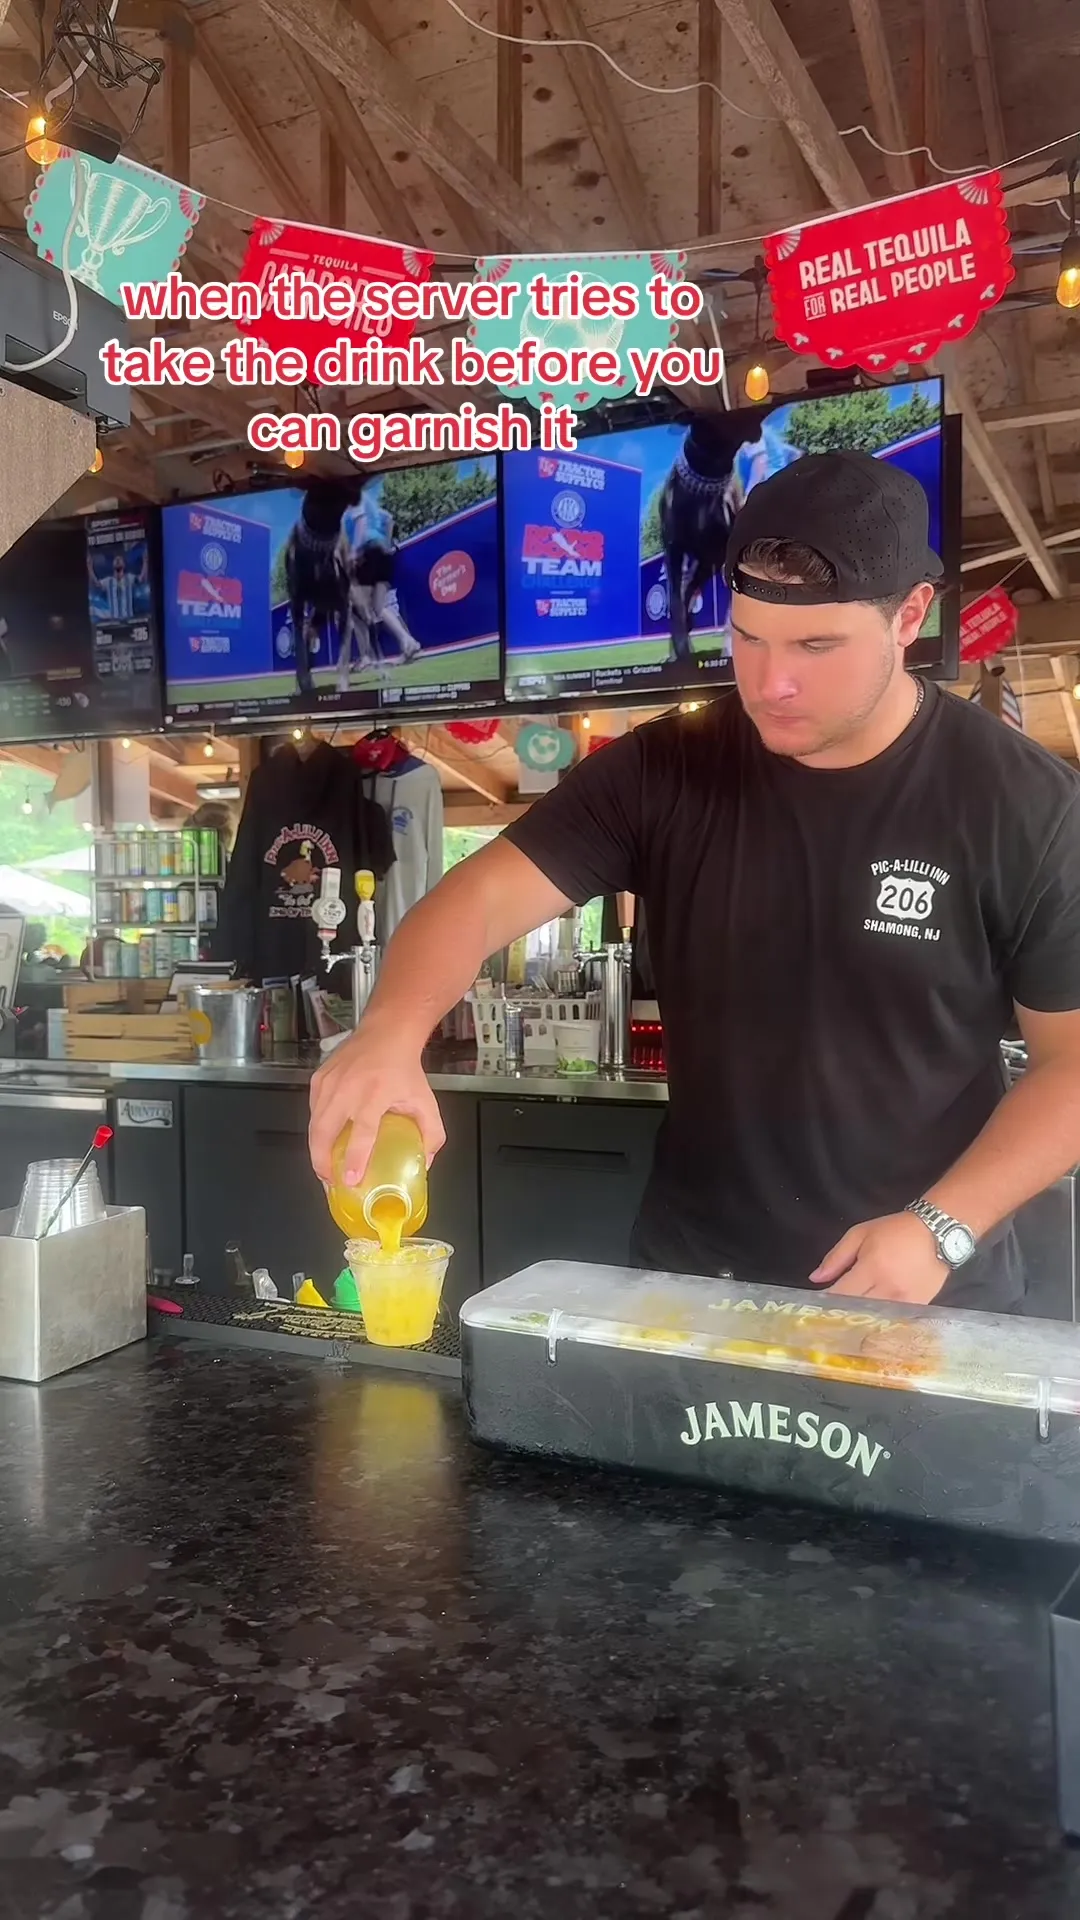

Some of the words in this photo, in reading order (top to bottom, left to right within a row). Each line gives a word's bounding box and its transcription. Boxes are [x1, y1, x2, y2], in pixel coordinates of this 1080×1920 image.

[313, 254, 359, 272] TEQUILA
[799, 248, 862, 290] REAL
[863, 217, 972, 271] TEQUILA
[804, 294, 827, 317] FOR
[830, 277, 887, 314] REAL
[891, 252, 976, 297] PEOPLE
[521, 556, 603, 577] TEAM
[177, 599, 242, 618] TEAM
[871, 859, 930, 876] PIC-A-LILLI
[929, 866, 951, 886] INN
[881, 885, 928, 914] 206
[863, 919, 921, 940] SHAMONG,
[924, 928, 941, 941] NJ
[708, 1299, 908, 1332] JAMESON
[681, 1401, 884, 1476] JAMESON
